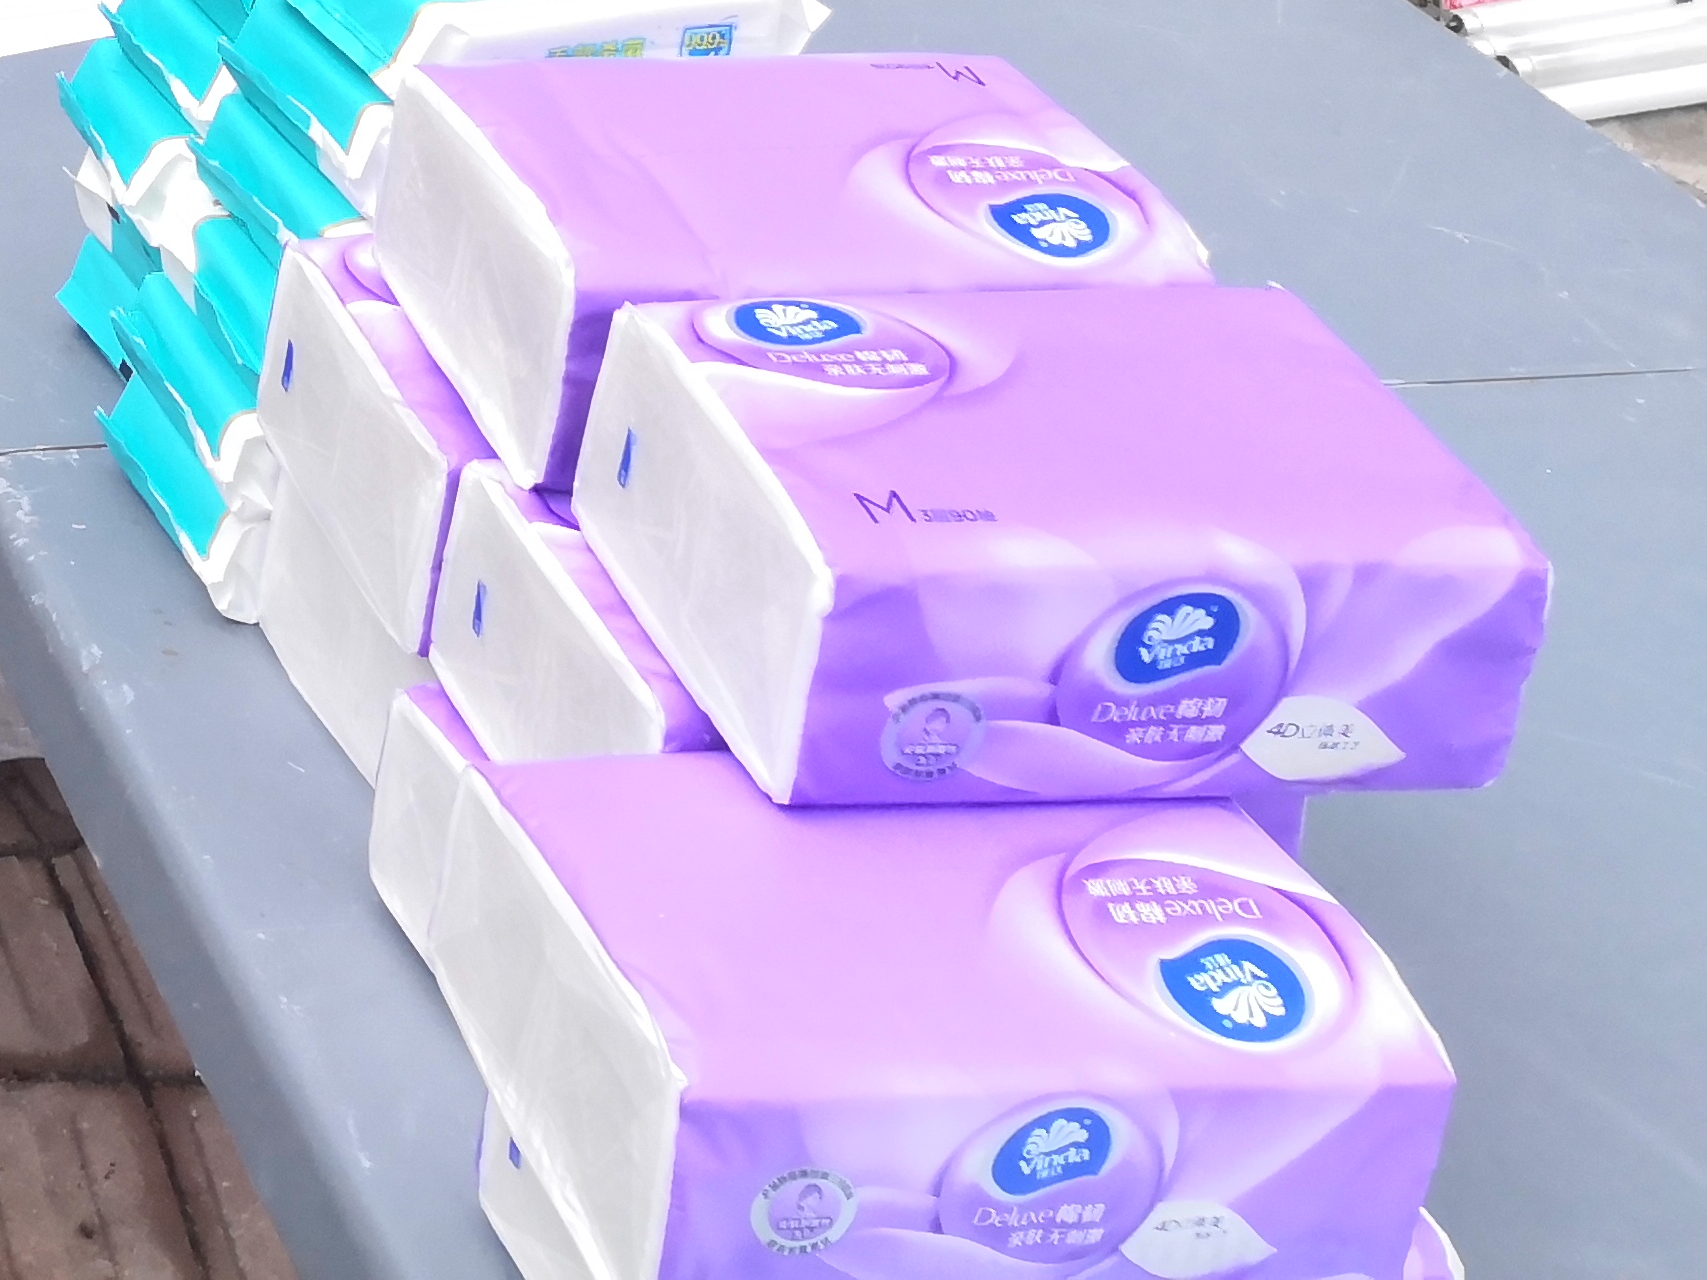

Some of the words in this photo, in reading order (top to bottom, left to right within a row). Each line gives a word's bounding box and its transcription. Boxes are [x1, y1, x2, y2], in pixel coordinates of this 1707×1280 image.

[766, 320, 838, 338] Vinda
[766, 350, 854, 364] Deluxe
[1138, 636, 1215, 664] Vinda
[1091, 700, 1177, 723] Deluxe
[1164, 896, 1263, 922] Deluxe
[1186, 960, 1269, 992] Vinda
[1018, 1145, 1091, 1176] Vinda
[973, 1205, 1054, 1227] Deluxe
